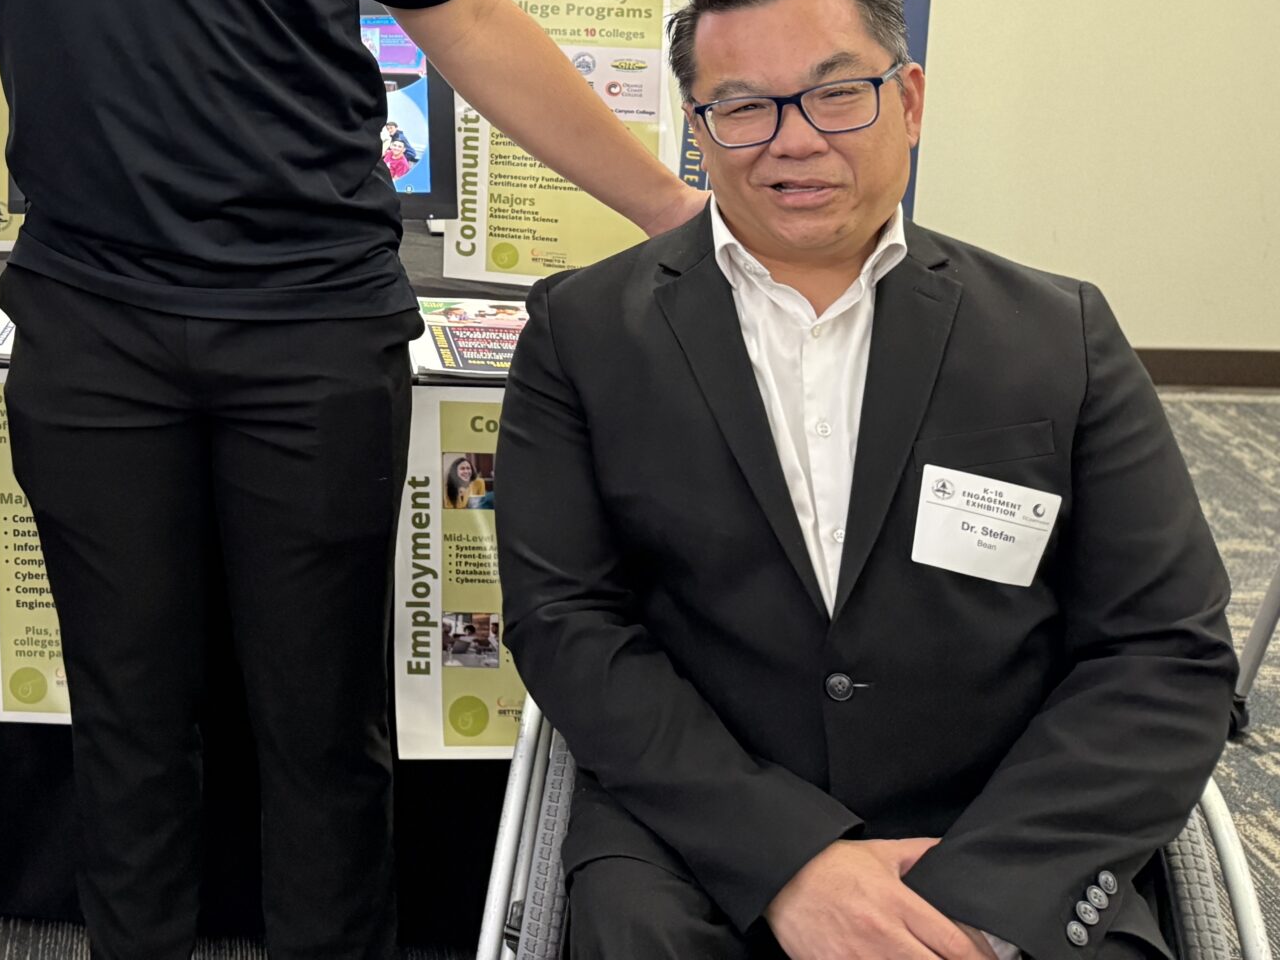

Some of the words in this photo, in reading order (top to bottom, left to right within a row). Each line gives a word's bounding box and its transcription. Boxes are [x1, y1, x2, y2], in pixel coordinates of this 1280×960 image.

[566, 3, 653, 21] Programs
[569, 27, 581, 36] at
[584, 27, 596, 37] 10
[598, 28, 645, 41] Colleges
[489, 172, 540, 182] Cybersecurity
[489, 180, 527, 188] Certificate
[489, 193, 535, 207] Majors
[489, 206, 509, 214] Cyber
[489, 225, 537, 234] Cybersecurity
[983, 487, 1004, 498] K-16
[962, 490, 1022, 511] ENGAGEMENT
[966, 499, 1016, 518] EXHIBITION
[13, 528, 38, 537] Data
[961, 521, 978, 534] Dr.
[980, 526, 1016, 543] Stefan
[976, 539, 997, 551] Bean
[455, 552, 491, 560] Front-End
[464, 561, 491, 569] Project
[405, 476, 438, 675] Employment
[25, 626, 52, 637] Plus,
[13, 637, 60, 649] colleges
[15, 649, 45, 657] more
